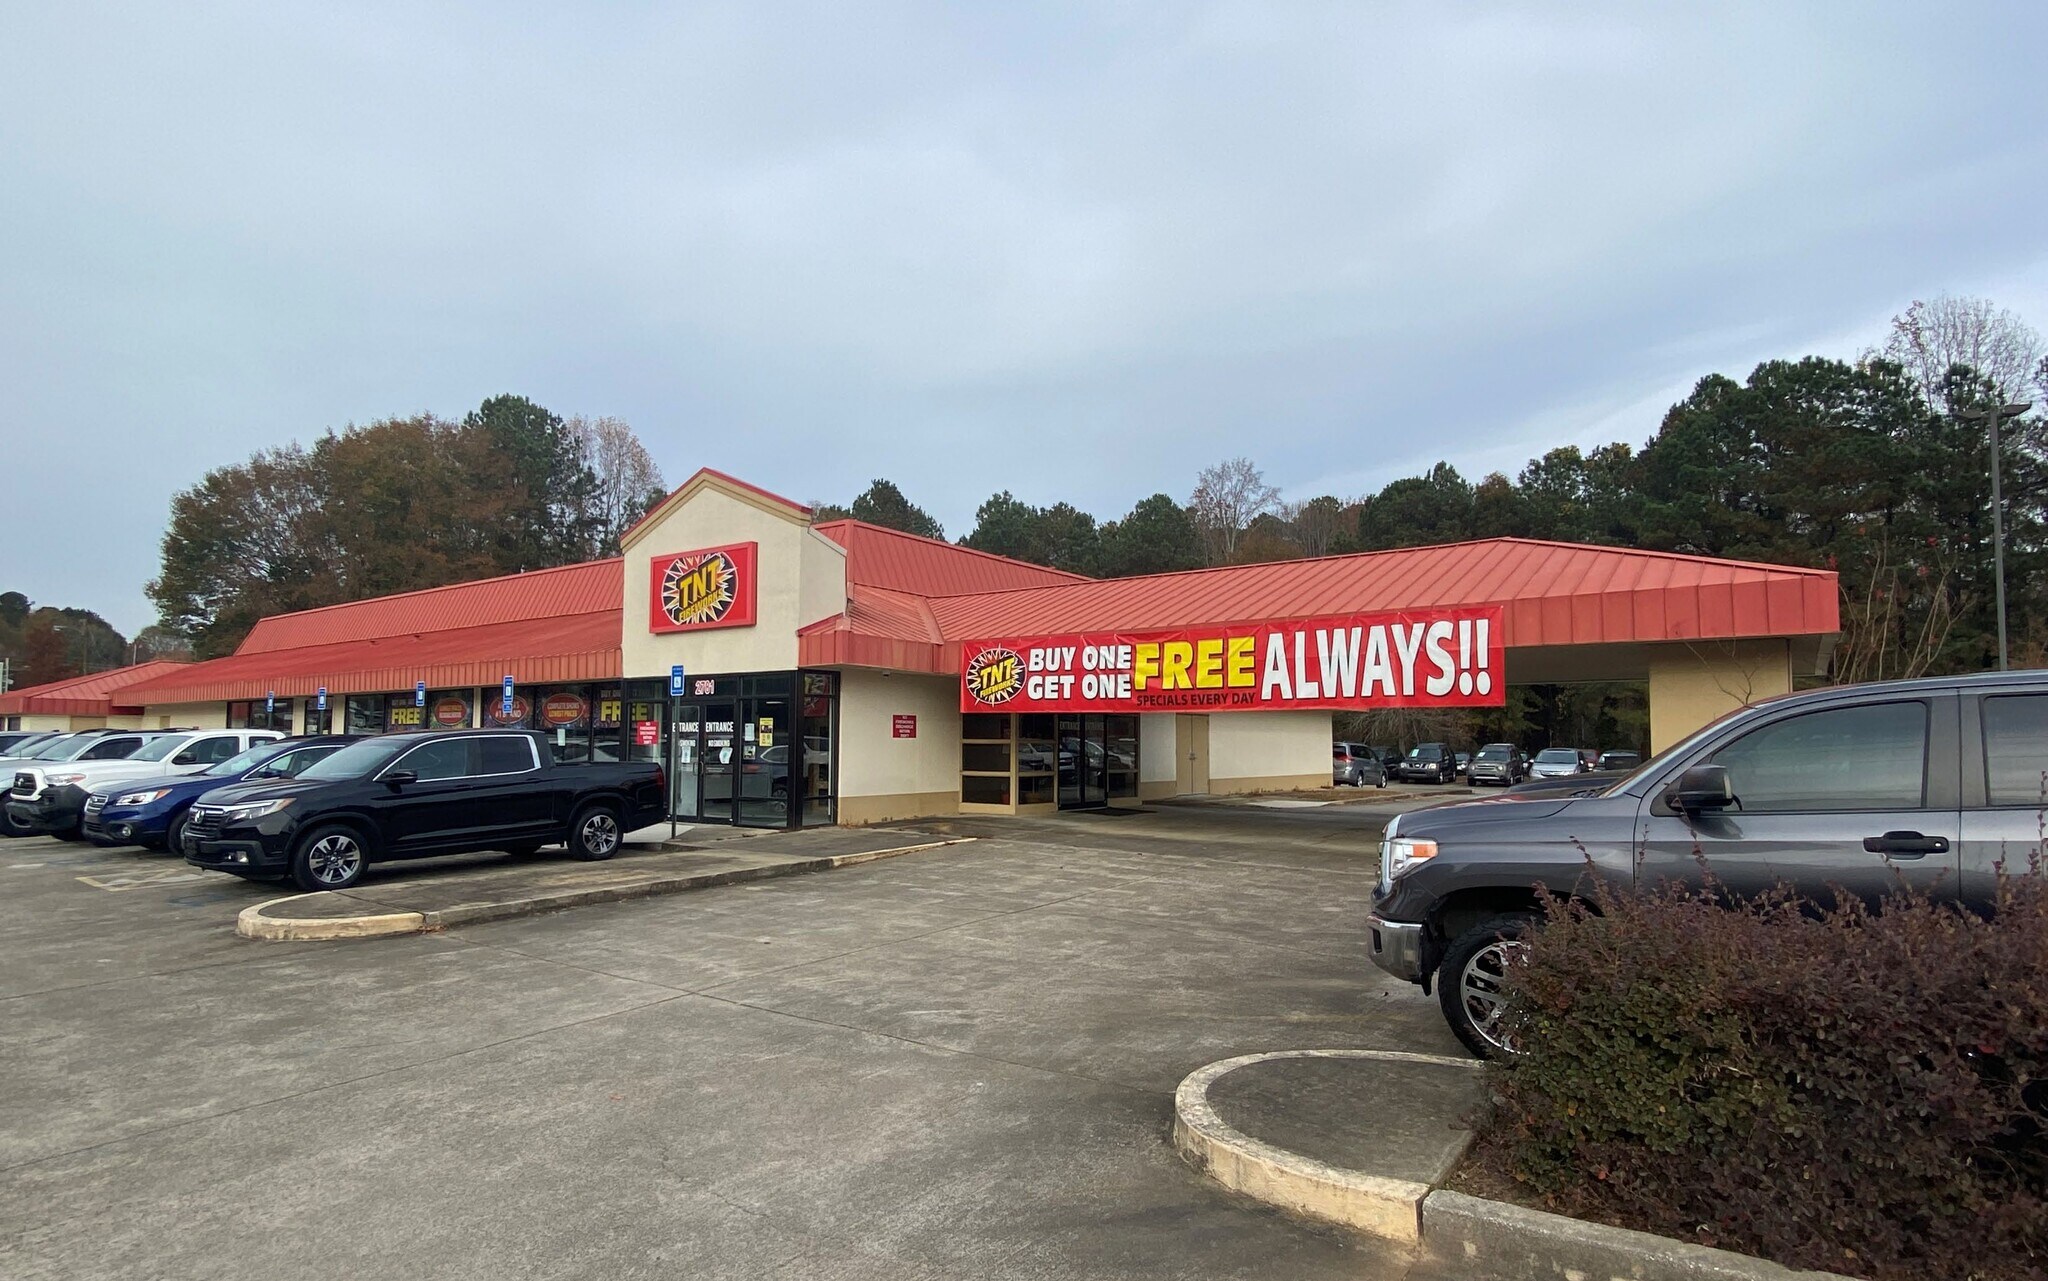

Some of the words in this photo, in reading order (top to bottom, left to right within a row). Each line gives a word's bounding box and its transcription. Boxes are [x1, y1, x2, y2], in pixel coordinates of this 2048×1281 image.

[679, 557, 721, 609] TNT
[679, 588, 723, 621] FIREWORKS
[1028, 646, 1076, 671] BUY
[1082, 645, 1132, 671] ONE
[1133, 636, 1256, 690] FREE
[1260, 618, 1491, 700] ALWAYS!!
[980, 657, 1015, 689] TNT
[980, 679, 1016, 698] FIREWORKS
[1027, 675, 1075, 700] GET
[1081, 674, 1132, 699] ONE
[1136, 694, 1188, 706] SPECIALS
[1190, 693, 1229, 705] EVERY
[1231, 692, 1256, 704] DAY
[391, 708, 420, 725] FREE
[672, 721, 699, 732] ETRANCE
[705, 721, 734, 732] ENTRANCE
